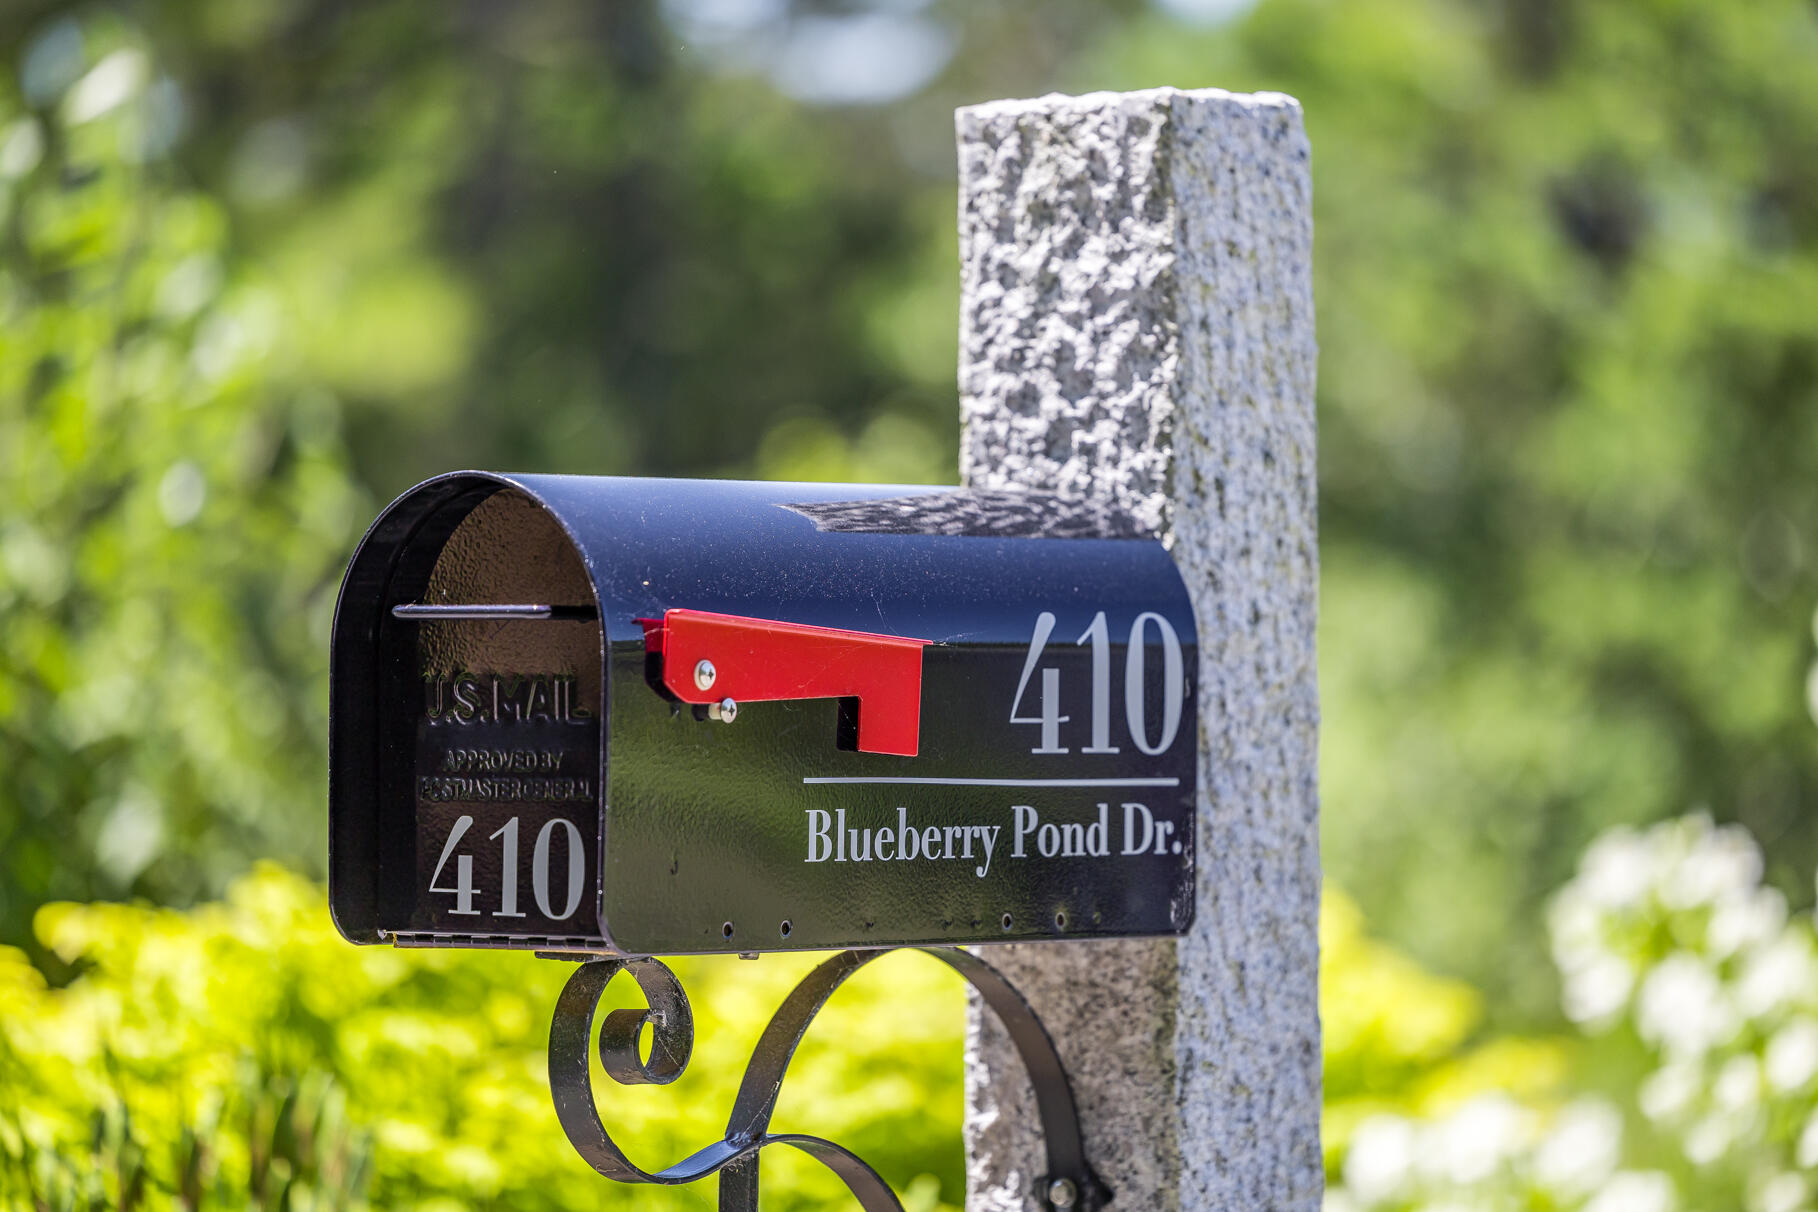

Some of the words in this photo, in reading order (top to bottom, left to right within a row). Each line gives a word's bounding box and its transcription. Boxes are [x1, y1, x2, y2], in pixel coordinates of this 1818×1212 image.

[492, 672, 594, 726] MAIL
[1009, 612, 1184, 755] 410
[445, 749, 538, 773] APPROVED
[540, 749, 565, 773] BY
[428, 815, 586, 920] 410
[804, 807, 1000, 877] Blueberry
[1010, 803, 1110, 858] Pond
[1121, 803, 1183, 856] Dr.
